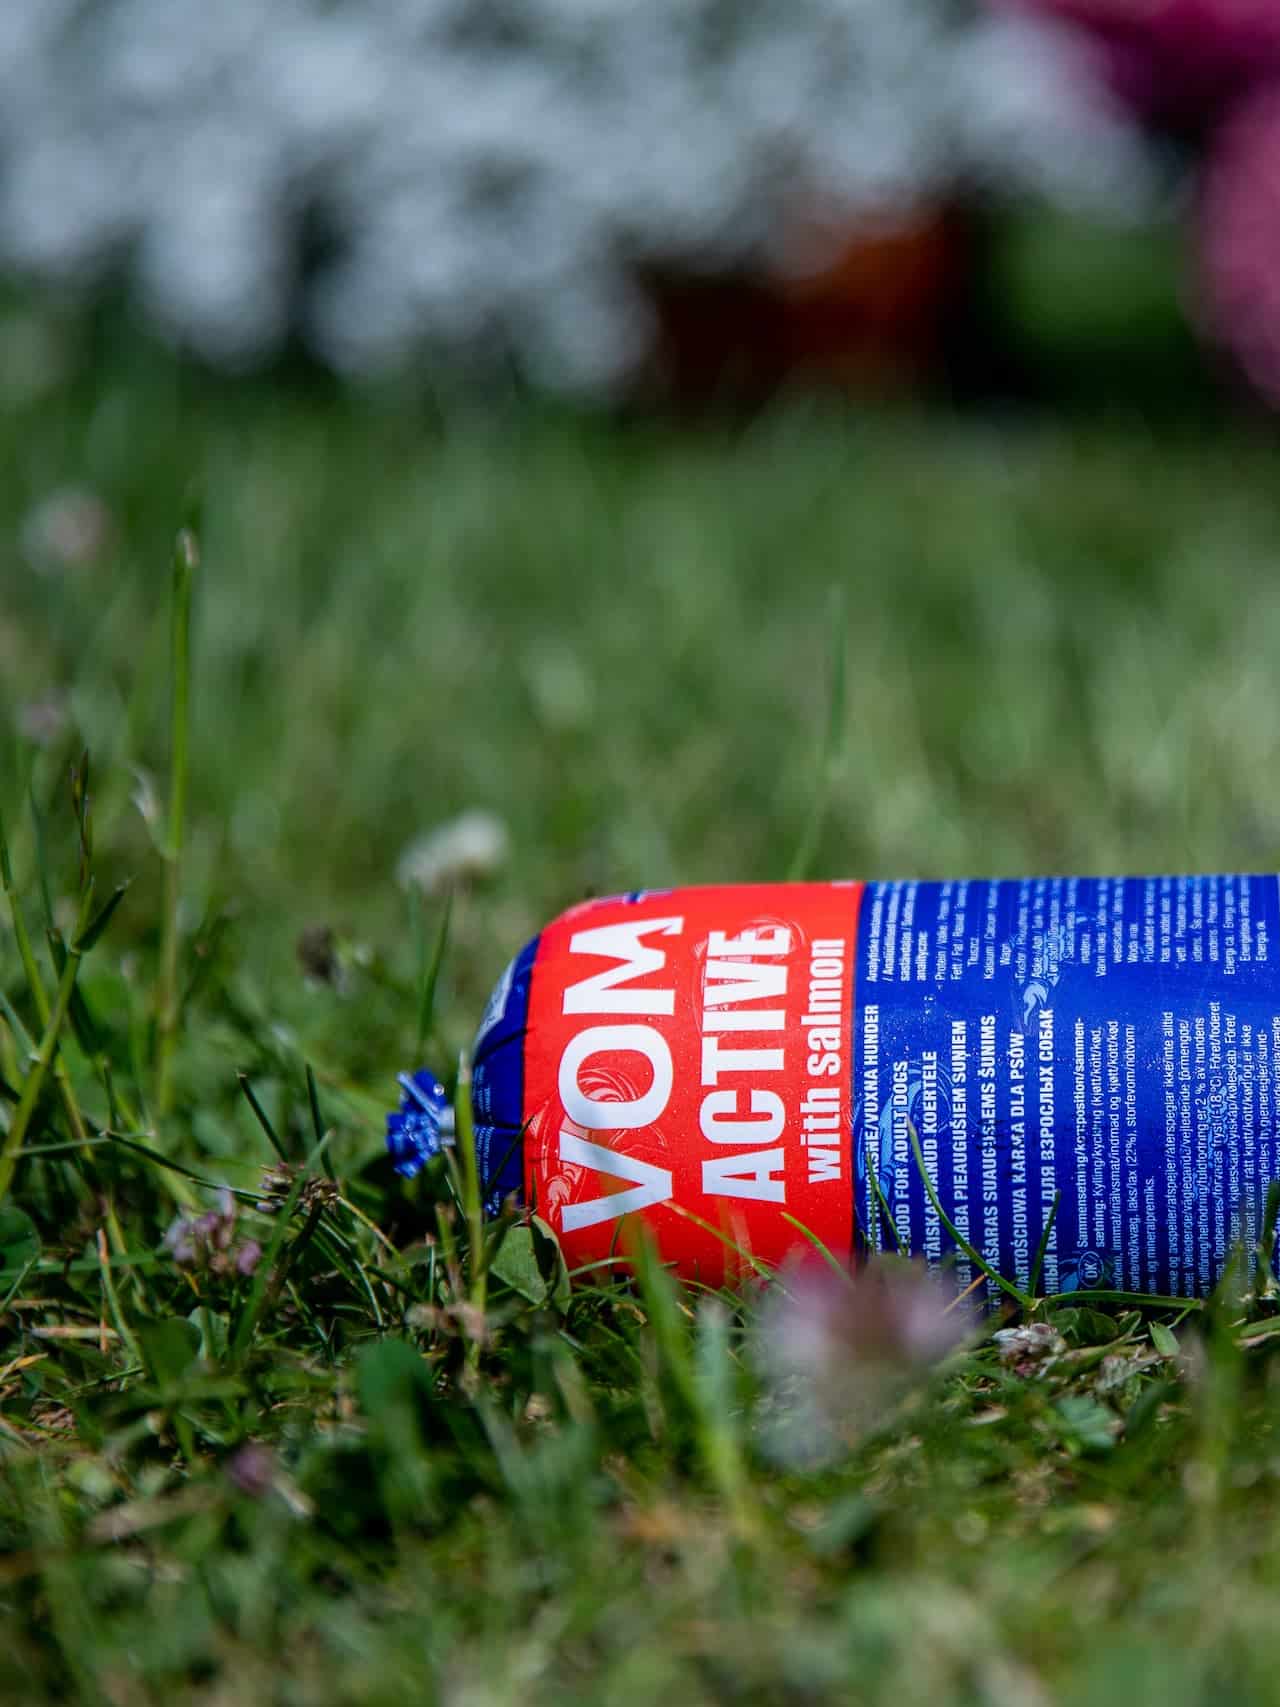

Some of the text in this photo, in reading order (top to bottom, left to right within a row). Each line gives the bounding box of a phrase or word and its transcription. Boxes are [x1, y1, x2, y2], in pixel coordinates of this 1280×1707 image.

[800, 938, 845, 1183] with salmon
[864, 1005, 879, 1065] HUNDER
[1007, 1033, 1025, 1080] PSÓW
[1039, 1009, 1053, 1061] СОБАК
[1240, 1024, 1252, 1046] ikke
[559, 916, 684, 1233] VOM
[700, 925, 791, 1204] ACTIVE
[892, 1061, 908, 1105] DOGS
[1195, 1083, 1206, 1094] %
[922, 1051, 938, 1133] KOERTELE
[1010, 1084, 1024, 1117] DLA
[1040, 1067, 1055, 1160] ВЗРОСЛЫХ
[1110, 1097, 1121, 1110] og
[893, 1111, 909, 1163] ADULT
[1010, 1122, 1026, 1183] KARMA
[894, 1169, 909, 1199] FOR
